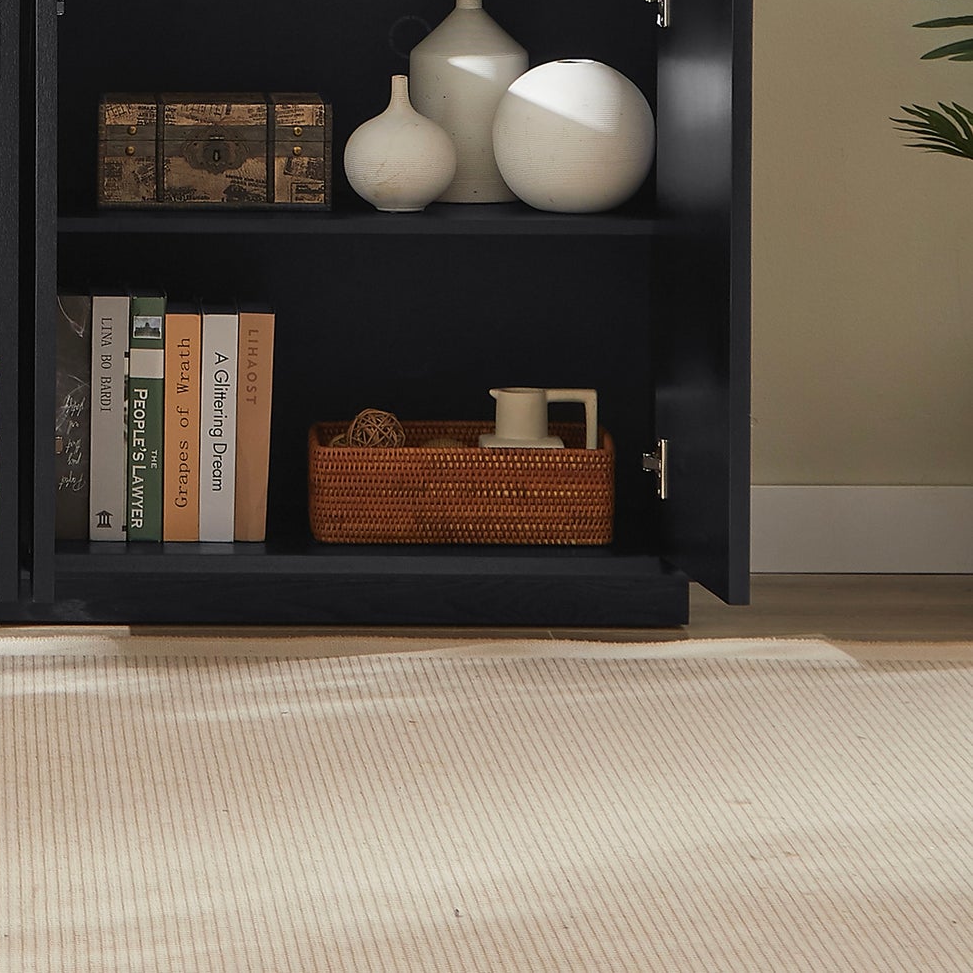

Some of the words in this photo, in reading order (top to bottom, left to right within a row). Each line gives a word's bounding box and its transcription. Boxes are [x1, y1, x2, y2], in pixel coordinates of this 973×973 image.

[101, 317, 113, 347] LINA
[100, 354, 113, 370] BO
[176, 337, 191, 395] Wrath
[214, 352, 229, 365] A
[246, 329, 259, 405] LIHAOST
[100, 376, 112, 412] BARDI
[177, 406, 190, 428] of
[209, 369, 231, 438] Glittering
[132, 388, 149, 462] PEOPLE'S
[150, 449, 158, 469] THE
[175, 440, 191, 508] Grapes
[212, 442, 228, 493] Dream
[130, 465, 147, 528] LAWYER
